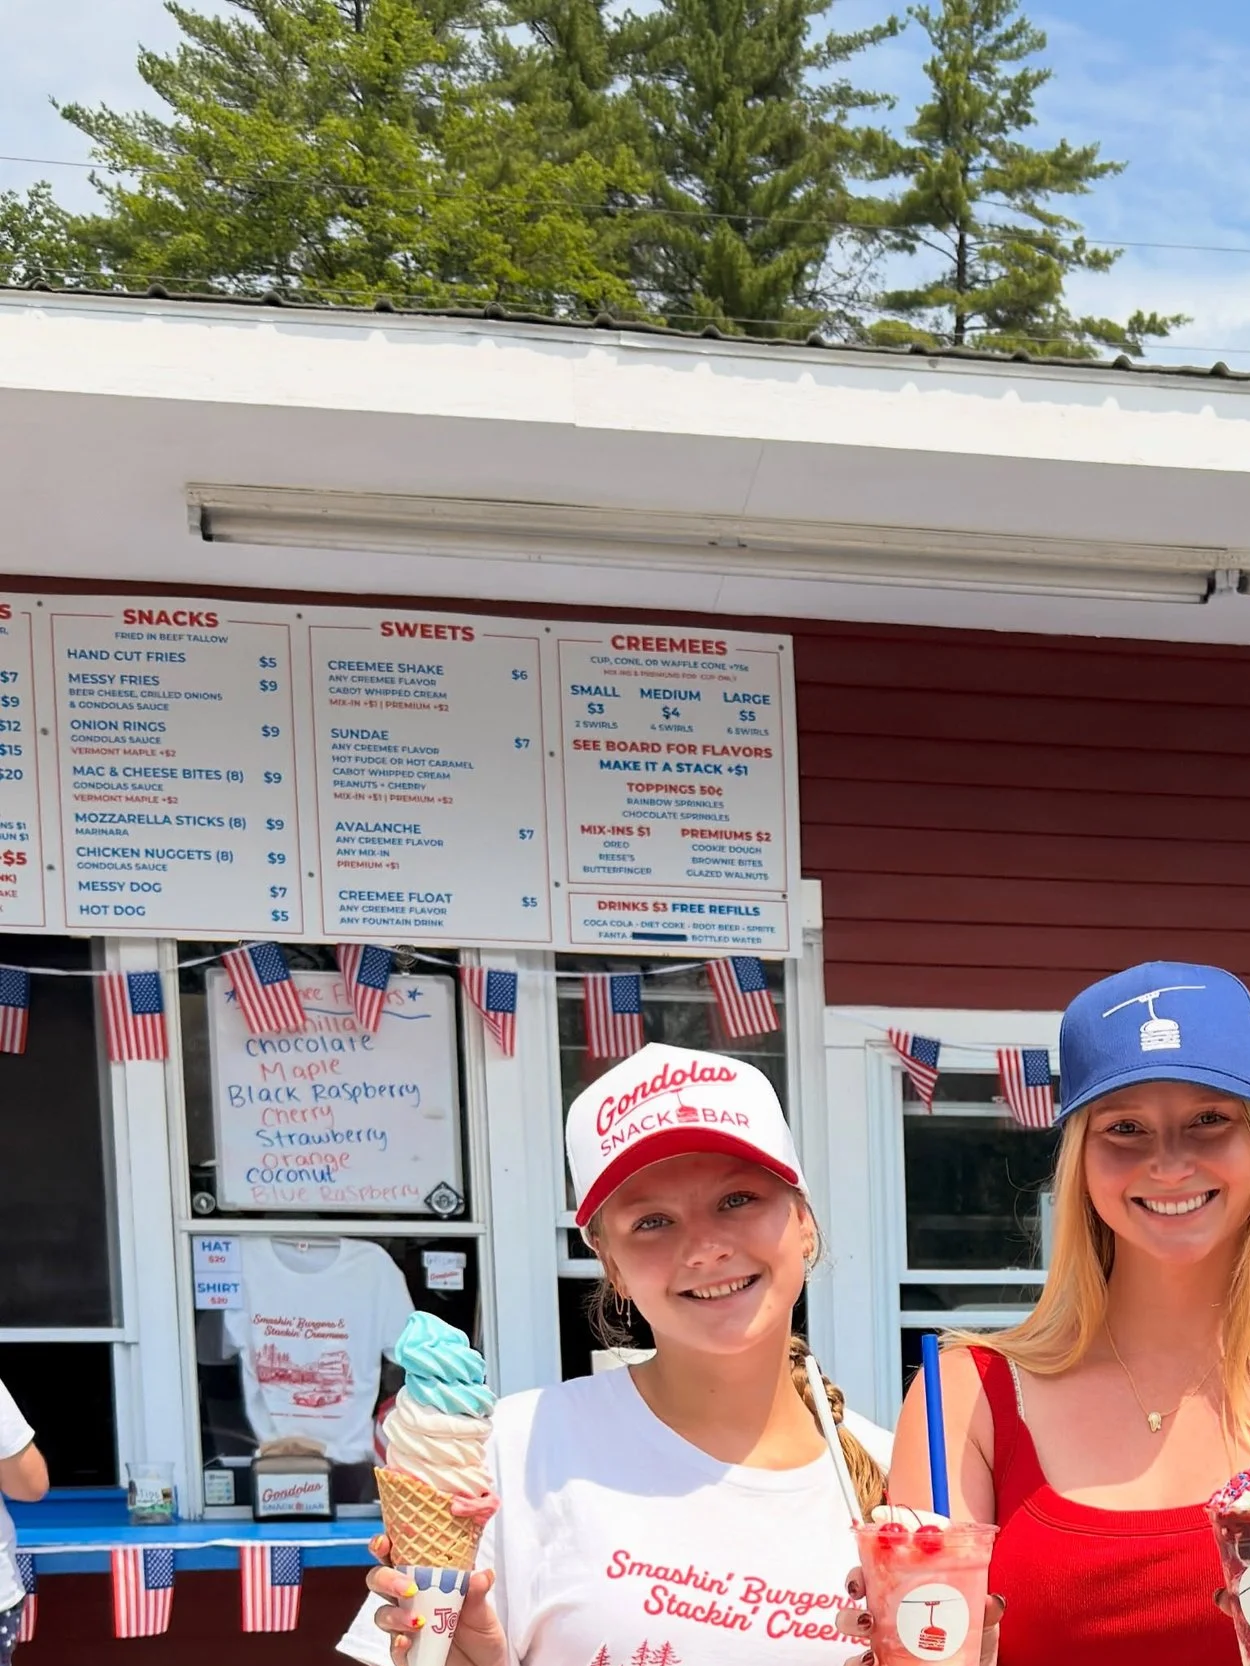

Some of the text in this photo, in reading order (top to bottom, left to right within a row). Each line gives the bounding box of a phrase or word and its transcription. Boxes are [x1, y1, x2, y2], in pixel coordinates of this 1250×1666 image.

[123, 609, 219, 627] SNACKS
[115, 632, 228, 643] FRIED IN BEEF TALLOW
[381, 621, 474, 642] SWEETS
[611, 634, 728, 656] CREEMEES
[67, 649, 186, 663] HAND CUT FRIES
[260, 656, 277, 669] $5
[328, 660, 444, 675] CREEMEE SHAKE
[0, 671, 18, 683] $7
[69, 674, 160, 686] MESSY FRIES
[512, 669, 528, 681] $6
[260, 680, 278, 693] $9
[571, 685, 620, 698] SMALL
[1, 695, 19, 707] $9
[640, 688, 701, 701] MEDIUM
[723, 692, 771, 706] LARGE
[587, 703, 605, 715] $3
[662, 706, 680, 719] $4
[739, 710, 756, 722] $5
[71, 720, 166, 732] ONION RINGS
[262, 726, 280, 738] $9
[331, 728, 389, 741] SUNDAE
[514, 737, 530, 749] $7
[573, 739, 773, 758] SEE BOARD FOR FLAVORS
[0, 744, 22, 756] $15
[600, 759, 748, 777] MAKE IT A STACK +$1
[73, 766, 244, 784] MAC & CHEESE BITES (8)
[264, 772, 282, 785] $9
[627, 782, 723, 796] TOPPINGS 50¢
[627, 797, 724, 809] RAINBOW SPRINKLES
[75, 812, 246, 830] MOZZARELLA STICKS (8)
[622, 810, 730, 822] CHOCOLATE SPRINKLES
[267, 819, 284, 831] $9
[336, 822, 422, 835] AVALANCHE
[581, 825, 651, 837] MIX-INS $1
[76, 827, 129, 837] MARINARA
[519, 828, 534, 840] $7
[681, 828, 771, 842] PREMIUMS $2
[604, 841, 629, 849] OREO
[692, 844, 762, 854] COOKIE DOUGH
[76, 847, 233, 864] CHICKEN NUGGETS (8)
[268, 852, 286, 865] $9
[692, 856, 763, 867] BROWNIE BITES
[583, 865, 652, 875] BUTTERFINGER
[687, 869, 769, 881] GLAZED WALNUTS
[79, 881, 161, 893] MESSY DOG
[270, 886, 287, 898] $7
[339, 890, 453, 904] CREEMEE FLOAT
[522, 897, 537, 908] $5
[80, 905, 145, 916] HOT DOG
[598, 900, 760, 916] DRINKS $3 FREE REFILLS
[271, 910, 289, 923] $5
[340, 917, 444, 927] ANY FOUNTAIN DRINK
[246, 1033, 375, 1057] Chocolate
[260, 1058, 342, 1082] Maple
[229, 1081, 420, 1107] Black Raspberry
[596, 1061, 737, 1136] Gondolas
[261, 1104, 333, 1128] Cherry
[601, 1108, 750, 1157] SNACK BAR
[256, 1129, 387, 1151] Strawberry
[262, 1152, 350, 1173] Orange
[202, 1241, 231, 1252] HAT
[198, 1283, 239, 1293] SHIRT
[262, 1481, 323, 1503] Gondolas
[606, 1549, 734, 1596] Smashin'
[644, 1585, 759, 1631] Stackin'
